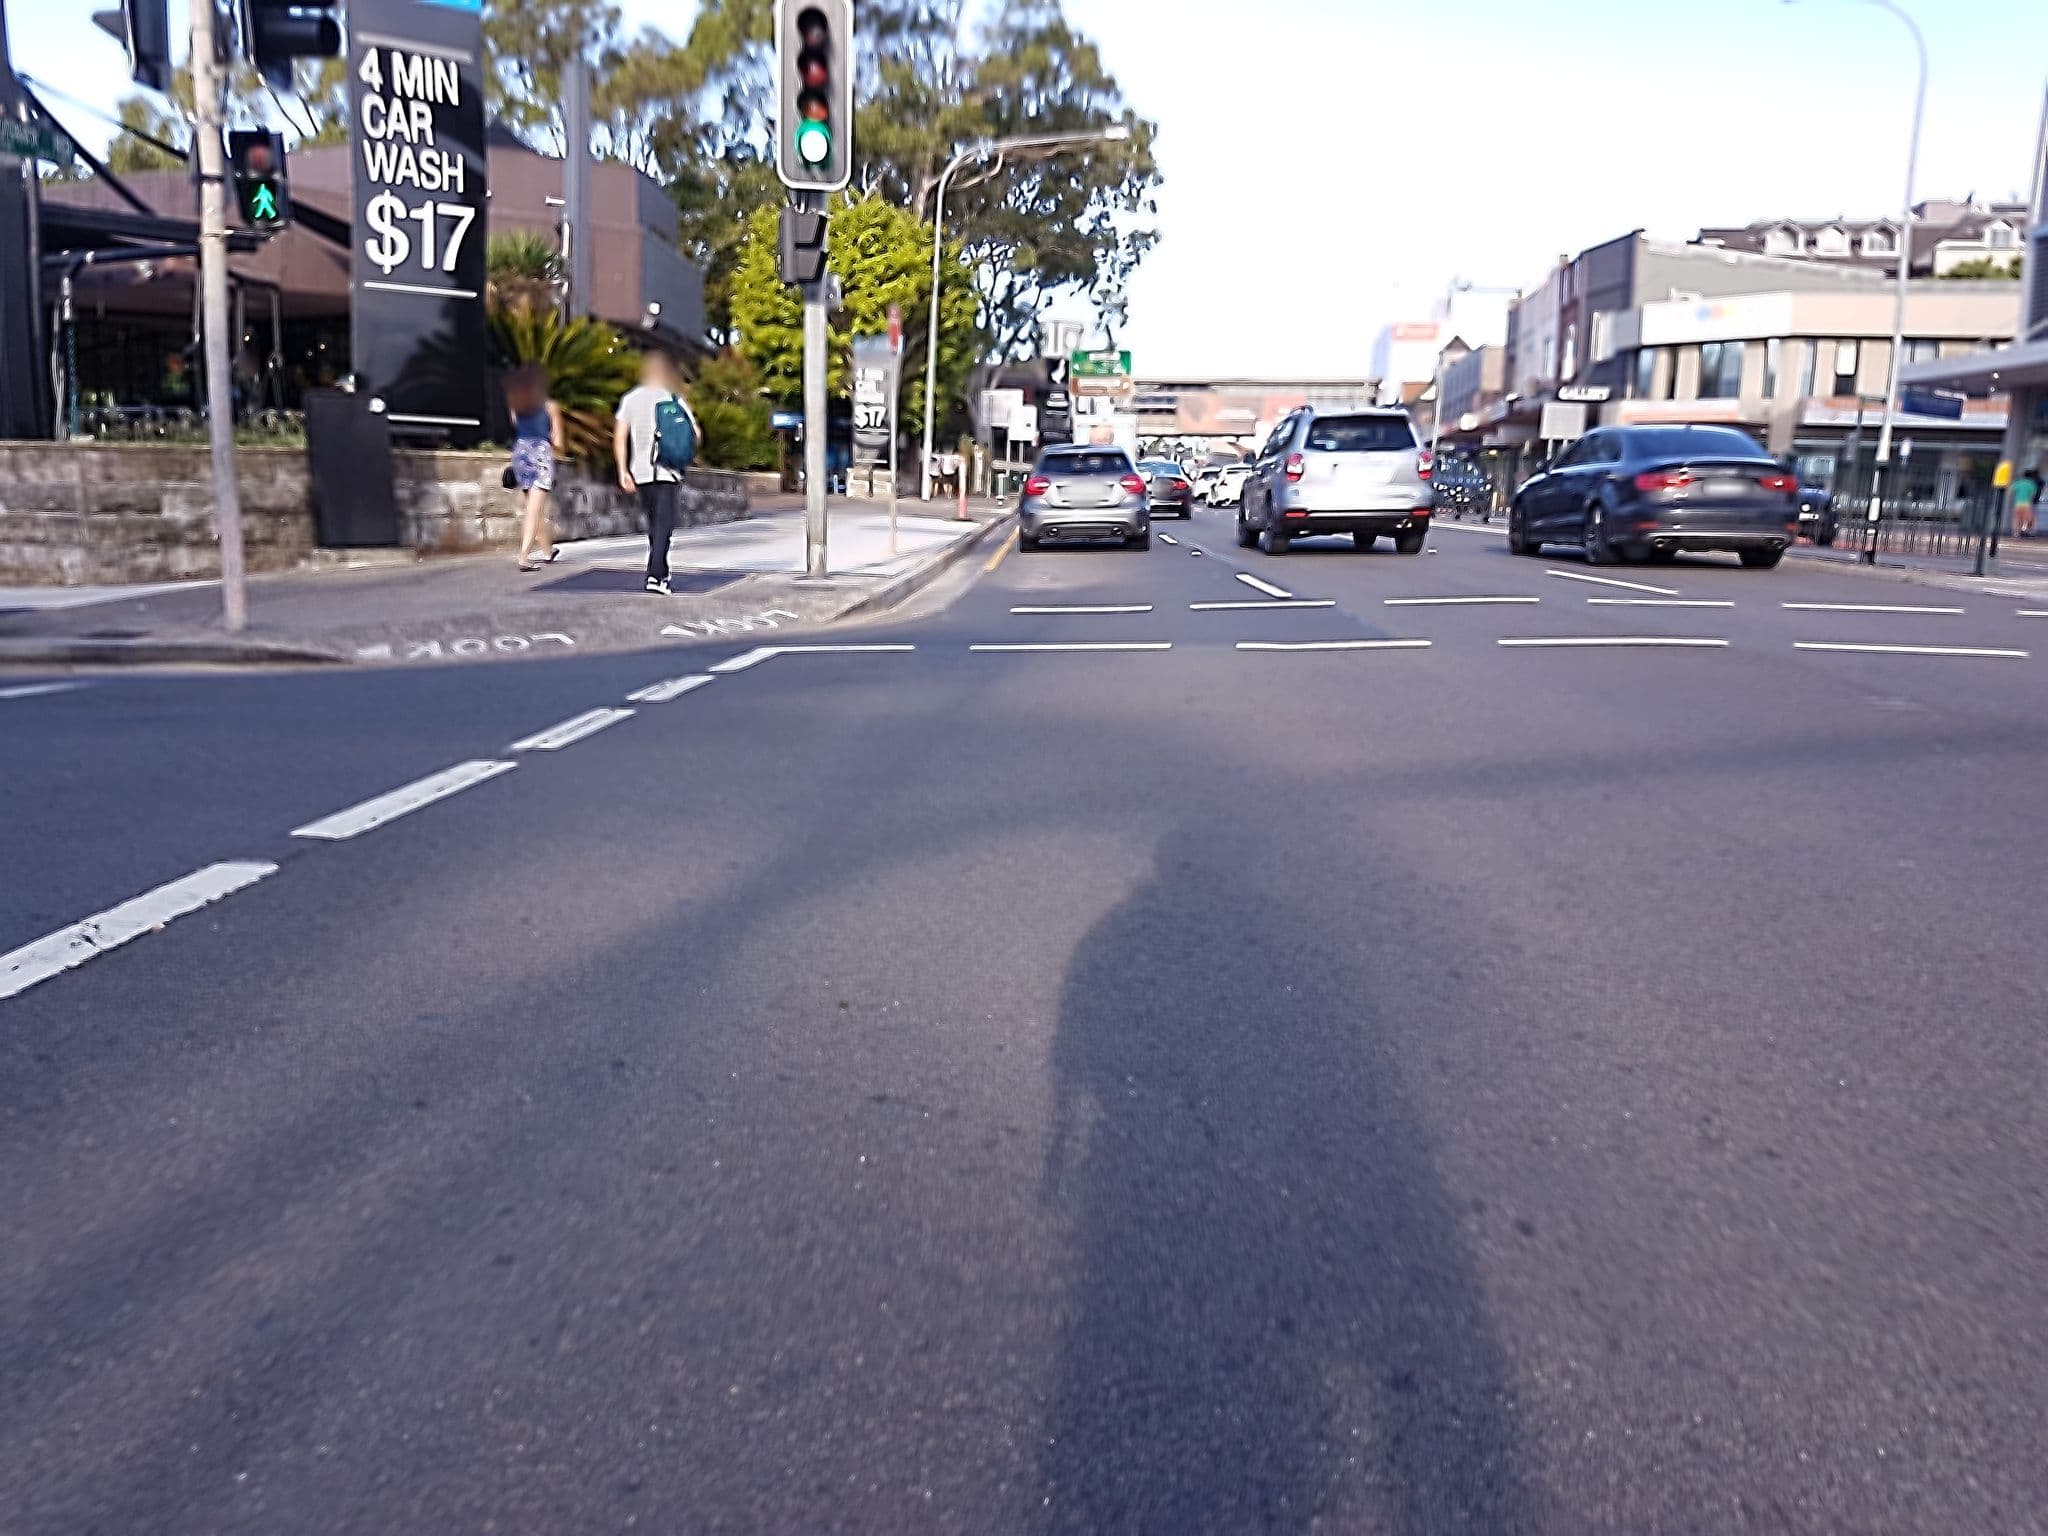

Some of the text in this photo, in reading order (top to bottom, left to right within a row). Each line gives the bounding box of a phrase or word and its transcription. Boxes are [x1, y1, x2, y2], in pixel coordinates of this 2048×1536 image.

[358, 47, 459, 106] 4 MIN
[361, 93, 434, 146] CAR
[363, 139, 464, 193] WASH
[364, 188, 475, 274] $17
[406, 633, 575, 660] LOOK
